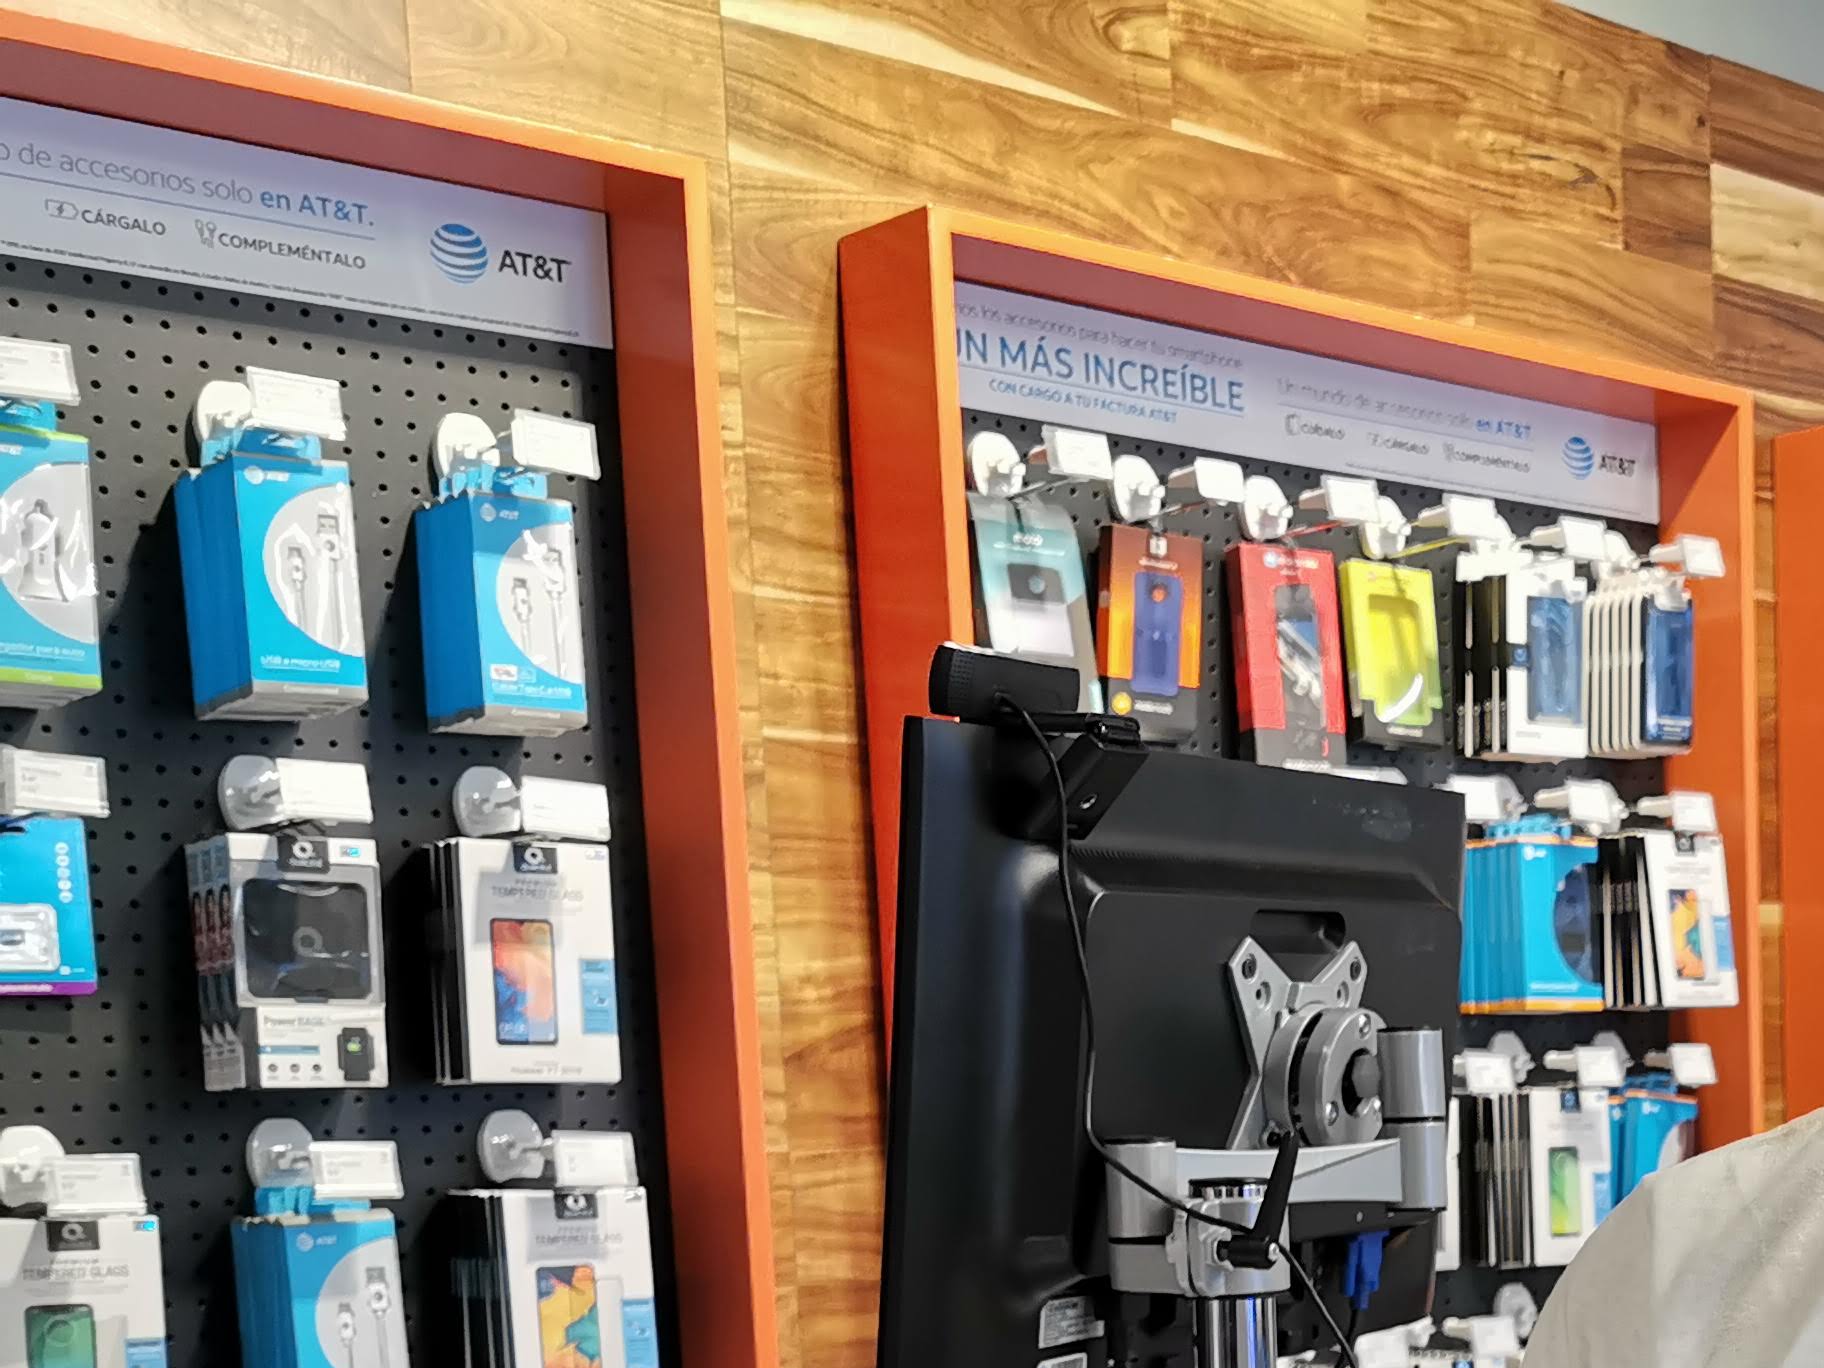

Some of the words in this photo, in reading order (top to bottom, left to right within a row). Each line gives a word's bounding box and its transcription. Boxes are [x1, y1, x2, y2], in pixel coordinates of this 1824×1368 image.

[18, 143, 51, 168] de
[60, 152, 196, 195] accesorios
[202, 179, 253, 204] solo
[260, 188, 291, 212] en
[81, 206, 166, 236] CÁRGALO
[218, 232, 367, 270] COMPLEMÉNTALO
[498, 249, 572, 283] AT&T
[999, 335, 1074, 379] MÁS
[1084, 352, 1245, 412] INCREÍBLE
[989, 378, 1017, 397] CON
[1018, 383, 1062, 403] CARGO
[1064, 392, 1074, 405] A
[1075, 394, 1093, 409] TU
[1094, 397, 1147, 419] FACTURA
[1599, 452, 1637, 478] AT&T
